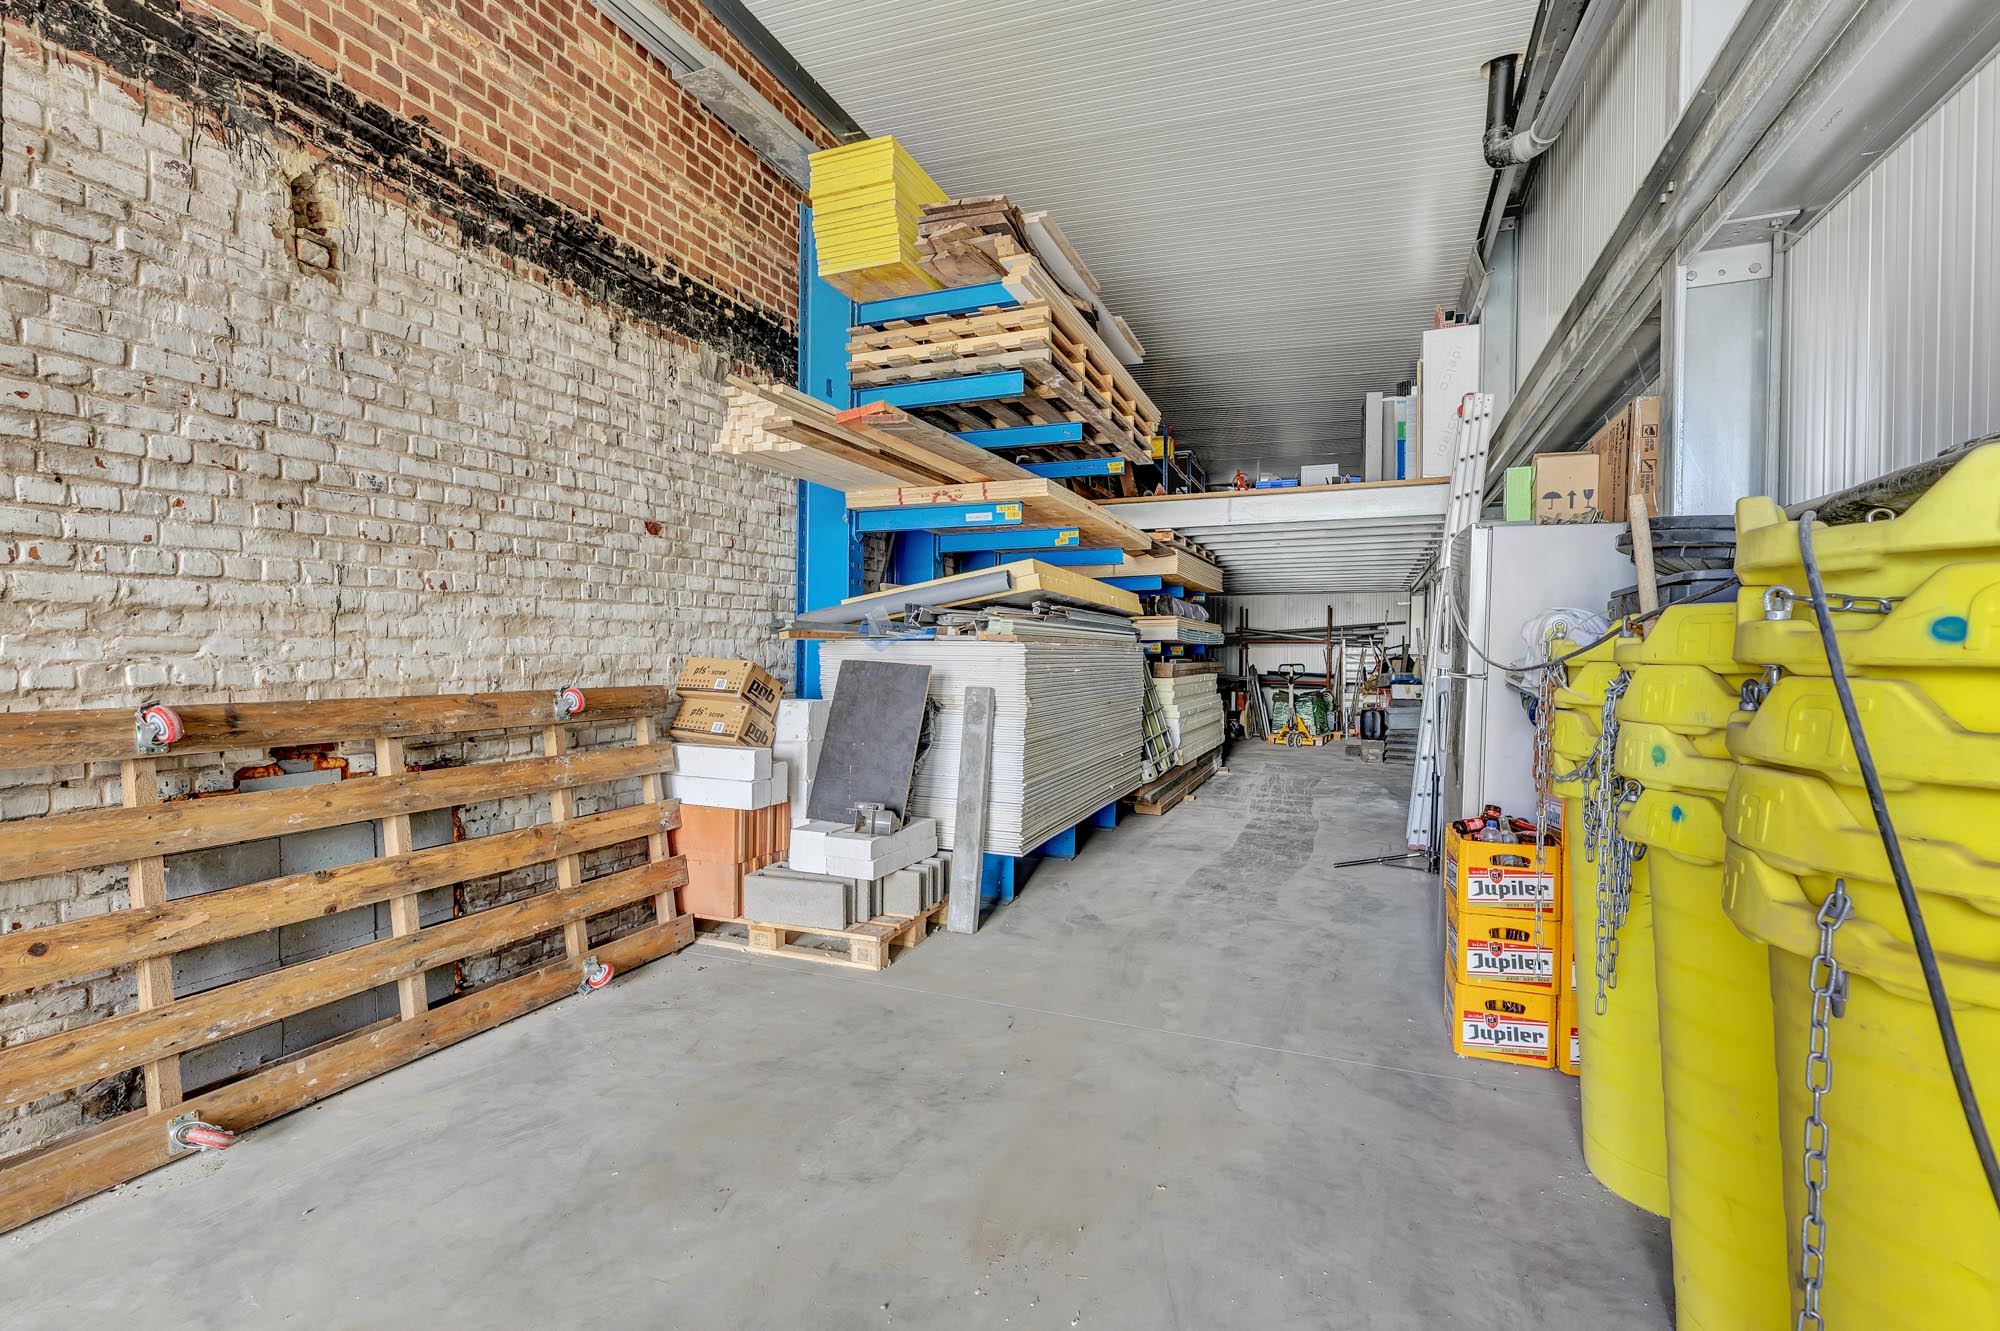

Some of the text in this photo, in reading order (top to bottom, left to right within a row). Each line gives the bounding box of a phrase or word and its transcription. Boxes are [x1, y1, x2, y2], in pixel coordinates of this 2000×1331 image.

[747, 679, 776, 704] pgb
[744, 721, 769, 746] pgb
[1472, 880, 1549, 900] Jupiler
[1472, 953, 1549, 973] Jupiler
[1468, 1024, 1544, 1044] Jupiler
